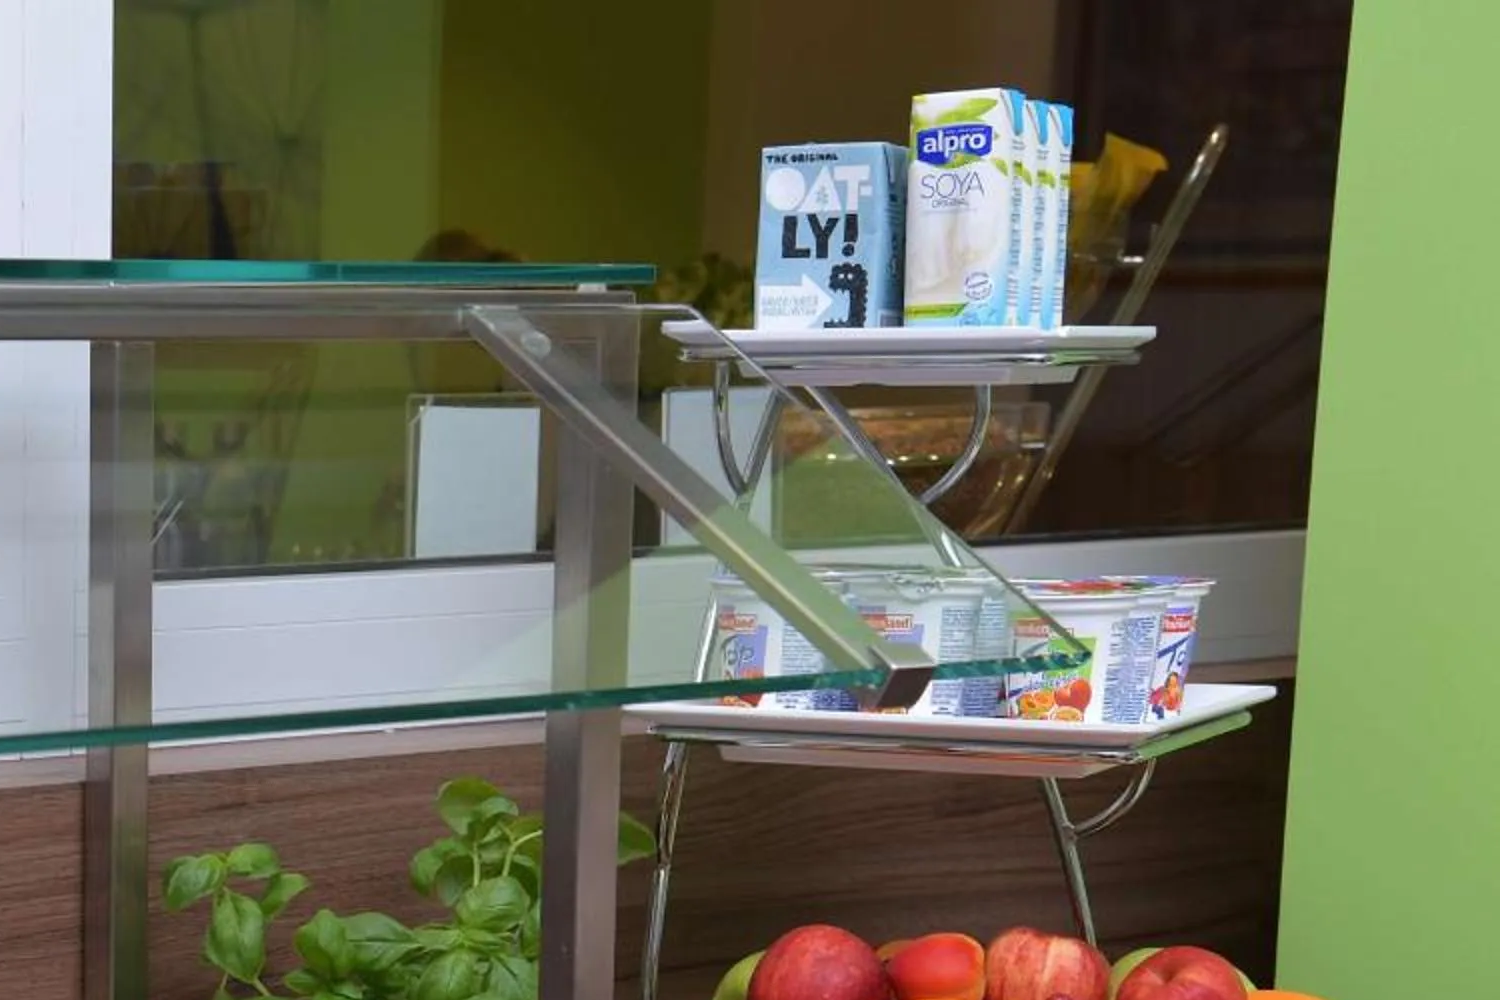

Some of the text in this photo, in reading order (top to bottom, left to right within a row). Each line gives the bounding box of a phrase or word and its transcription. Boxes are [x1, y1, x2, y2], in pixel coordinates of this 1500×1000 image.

[923, 130, 987, 158] alpro
[766, 153, 838, 164] THE ORIGINAL
[920, 171, 986, 199] SOYA
[782, 213, 859, 259] LY!
